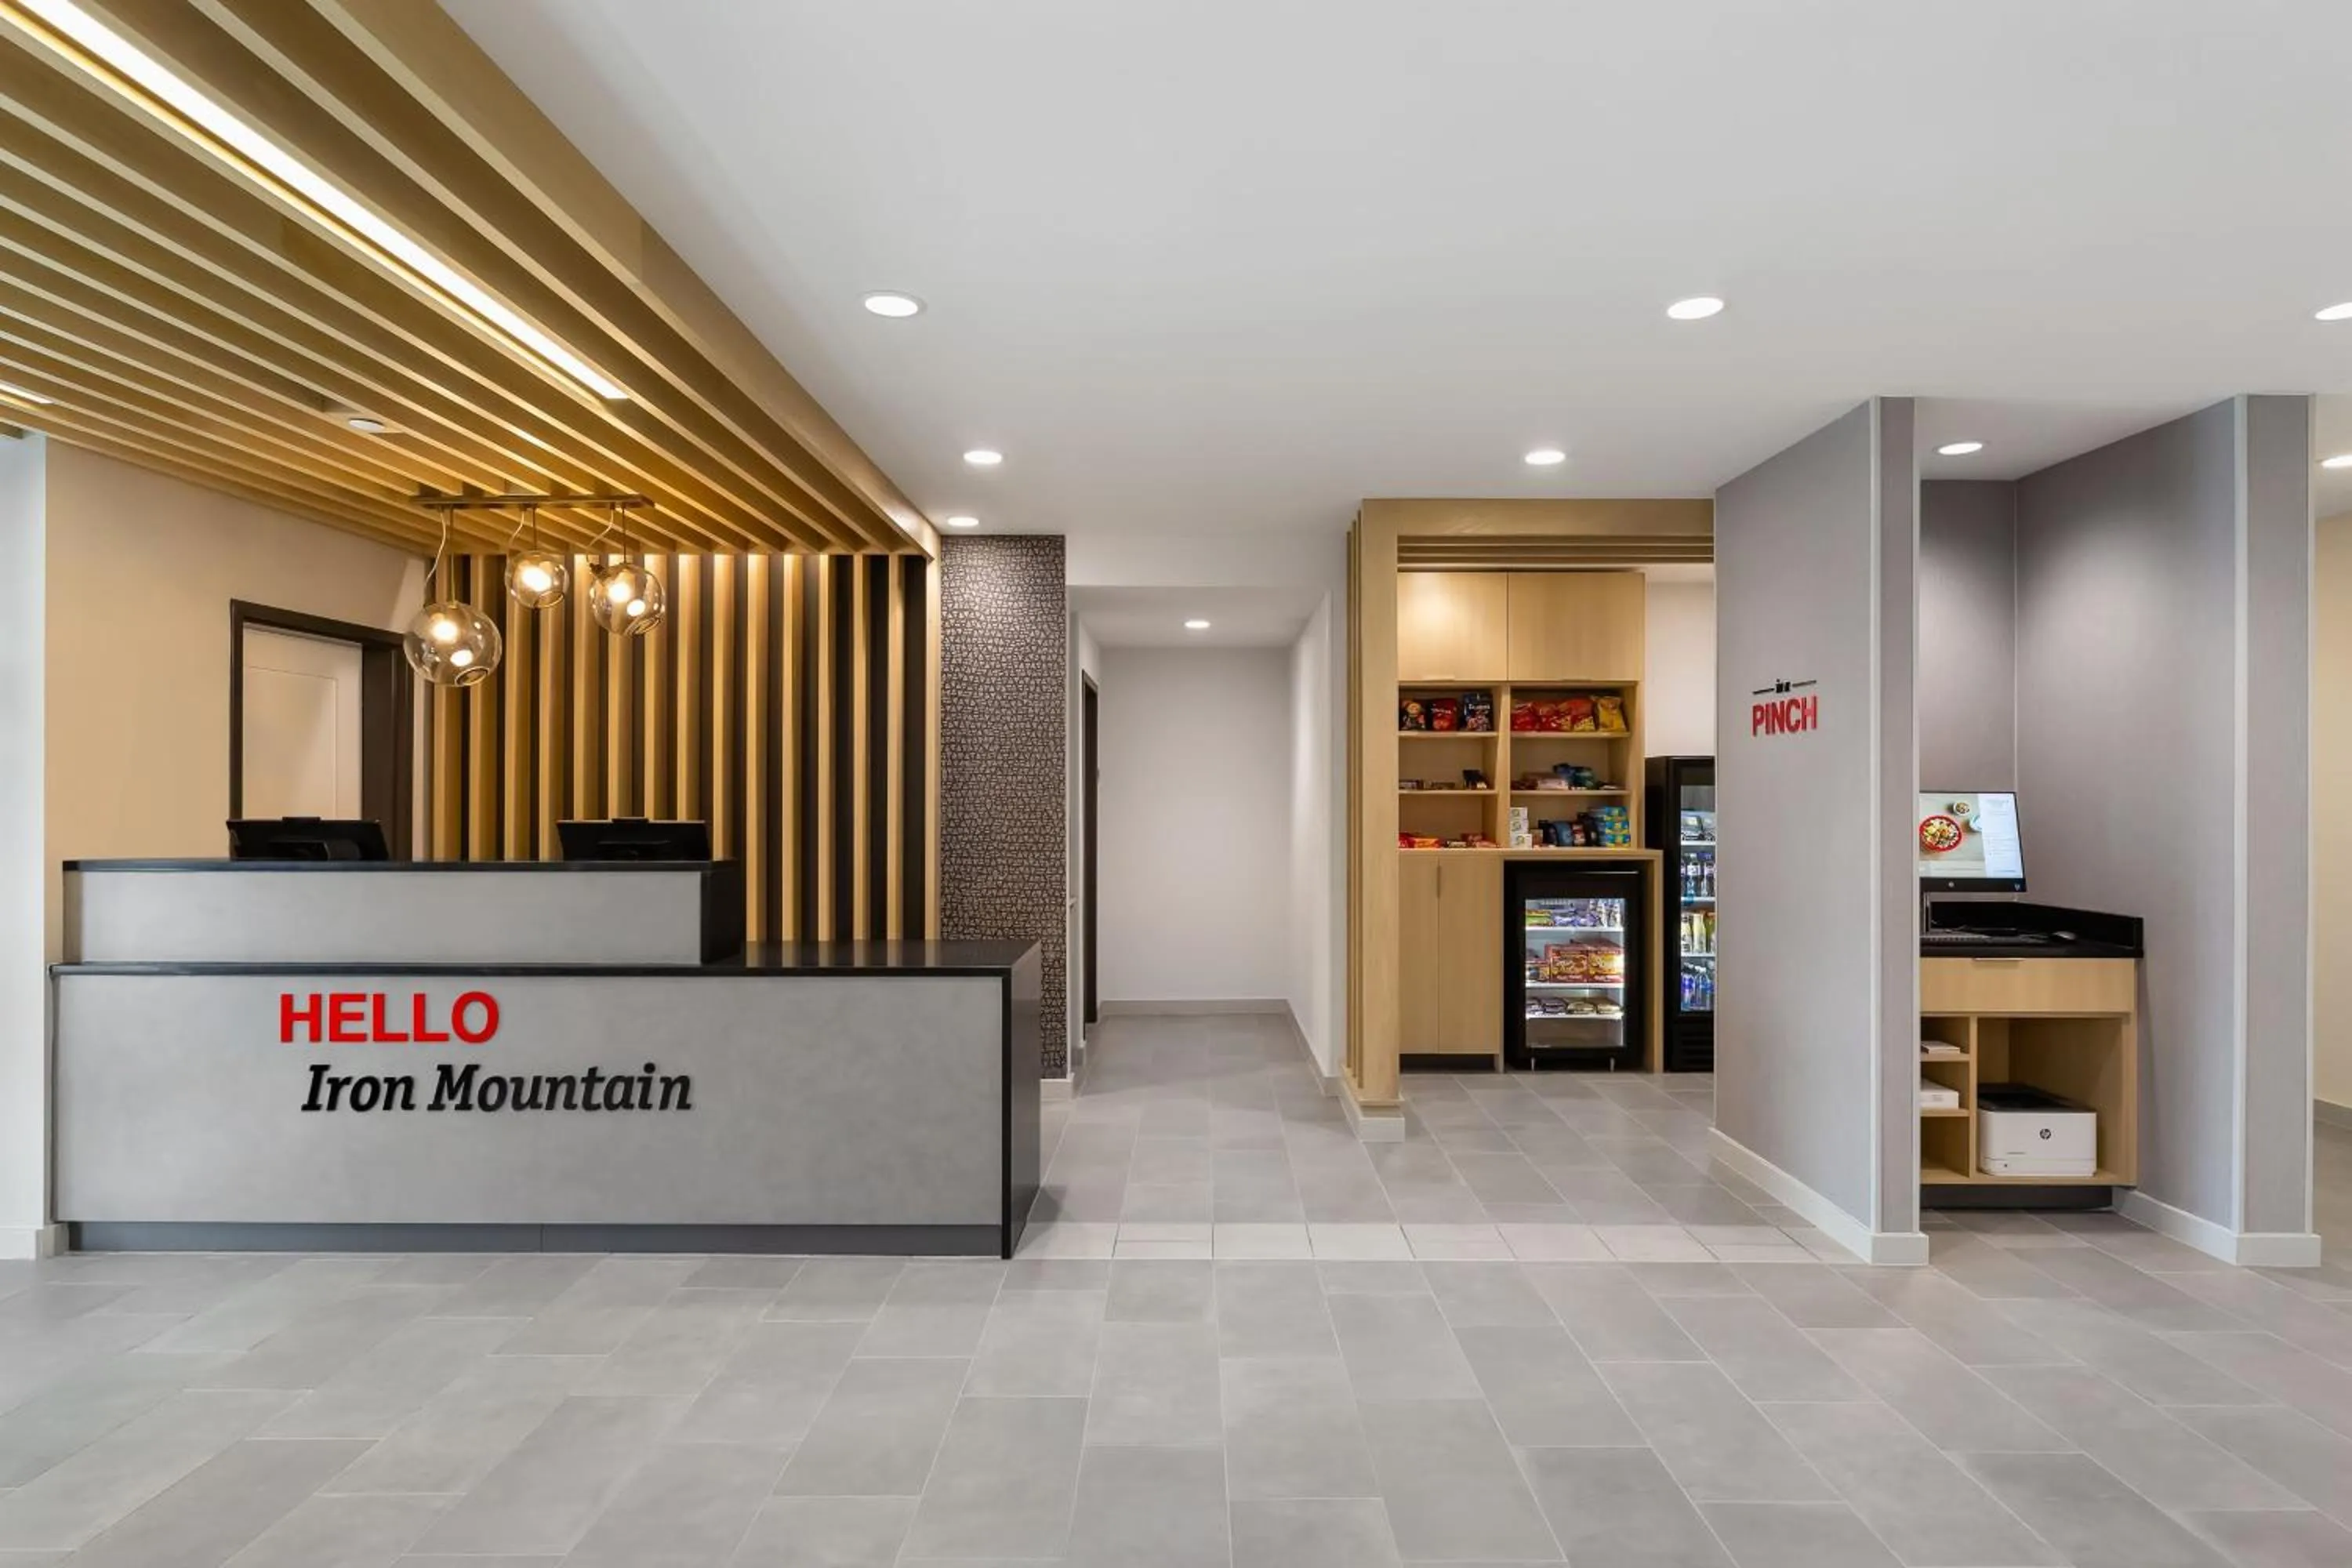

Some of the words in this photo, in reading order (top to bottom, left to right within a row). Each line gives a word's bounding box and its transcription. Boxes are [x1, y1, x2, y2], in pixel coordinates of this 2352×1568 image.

[1752, 695, 1817, 737] PINCH
[280, 991, 500, 1044] HELLO
[301, 1064, 416, 1112] Iron
[427, 1062, 692, 1112] Mountain
